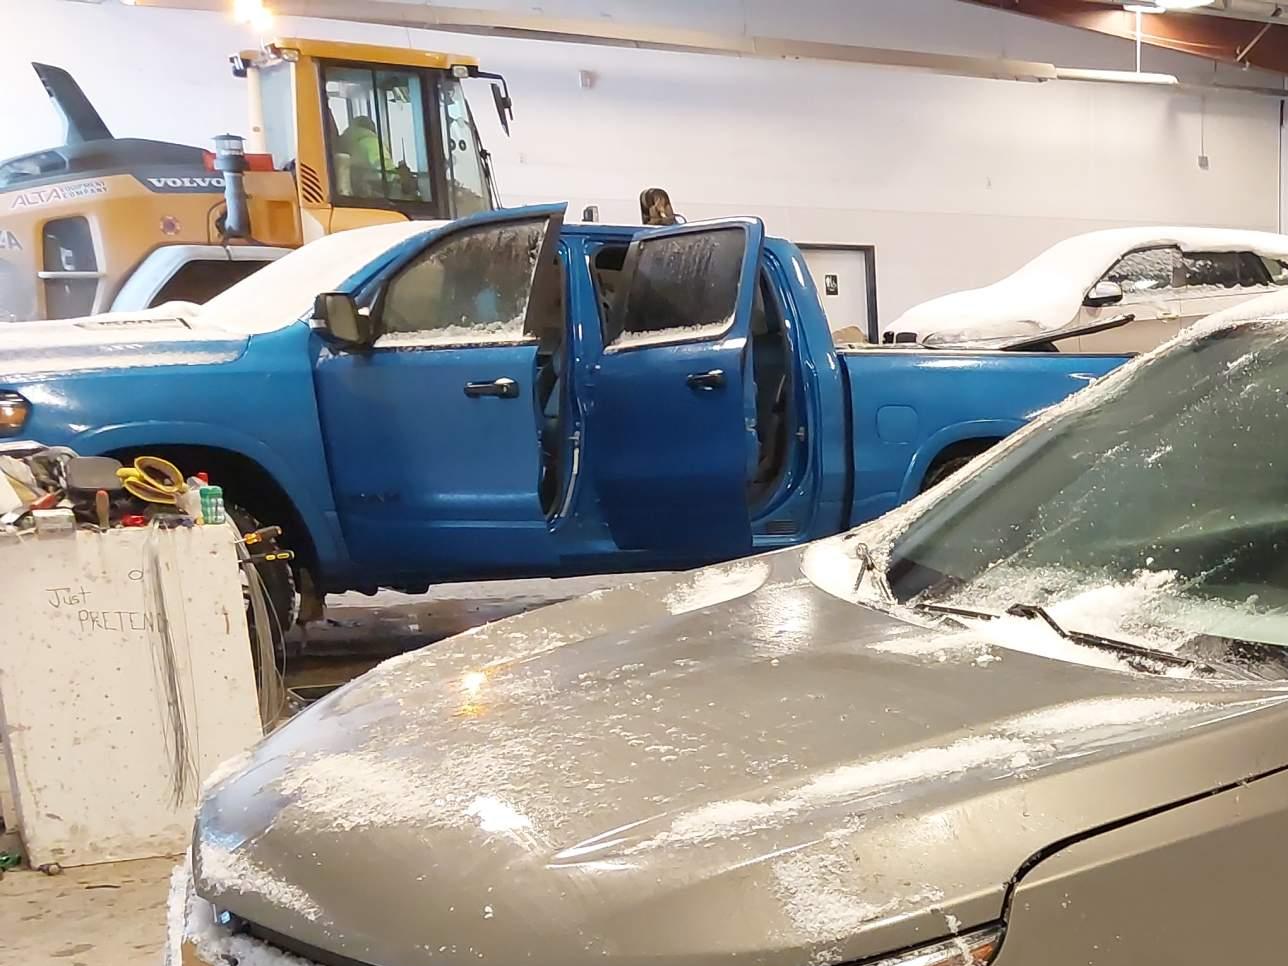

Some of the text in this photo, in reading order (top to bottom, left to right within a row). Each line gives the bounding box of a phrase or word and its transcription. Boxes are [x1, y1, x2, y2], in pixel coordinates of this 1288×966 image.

[147, 177, 225, 188] VOLVO
[11, 186, 62, 209] ALTA
[45, 585, 92, 609] Just
